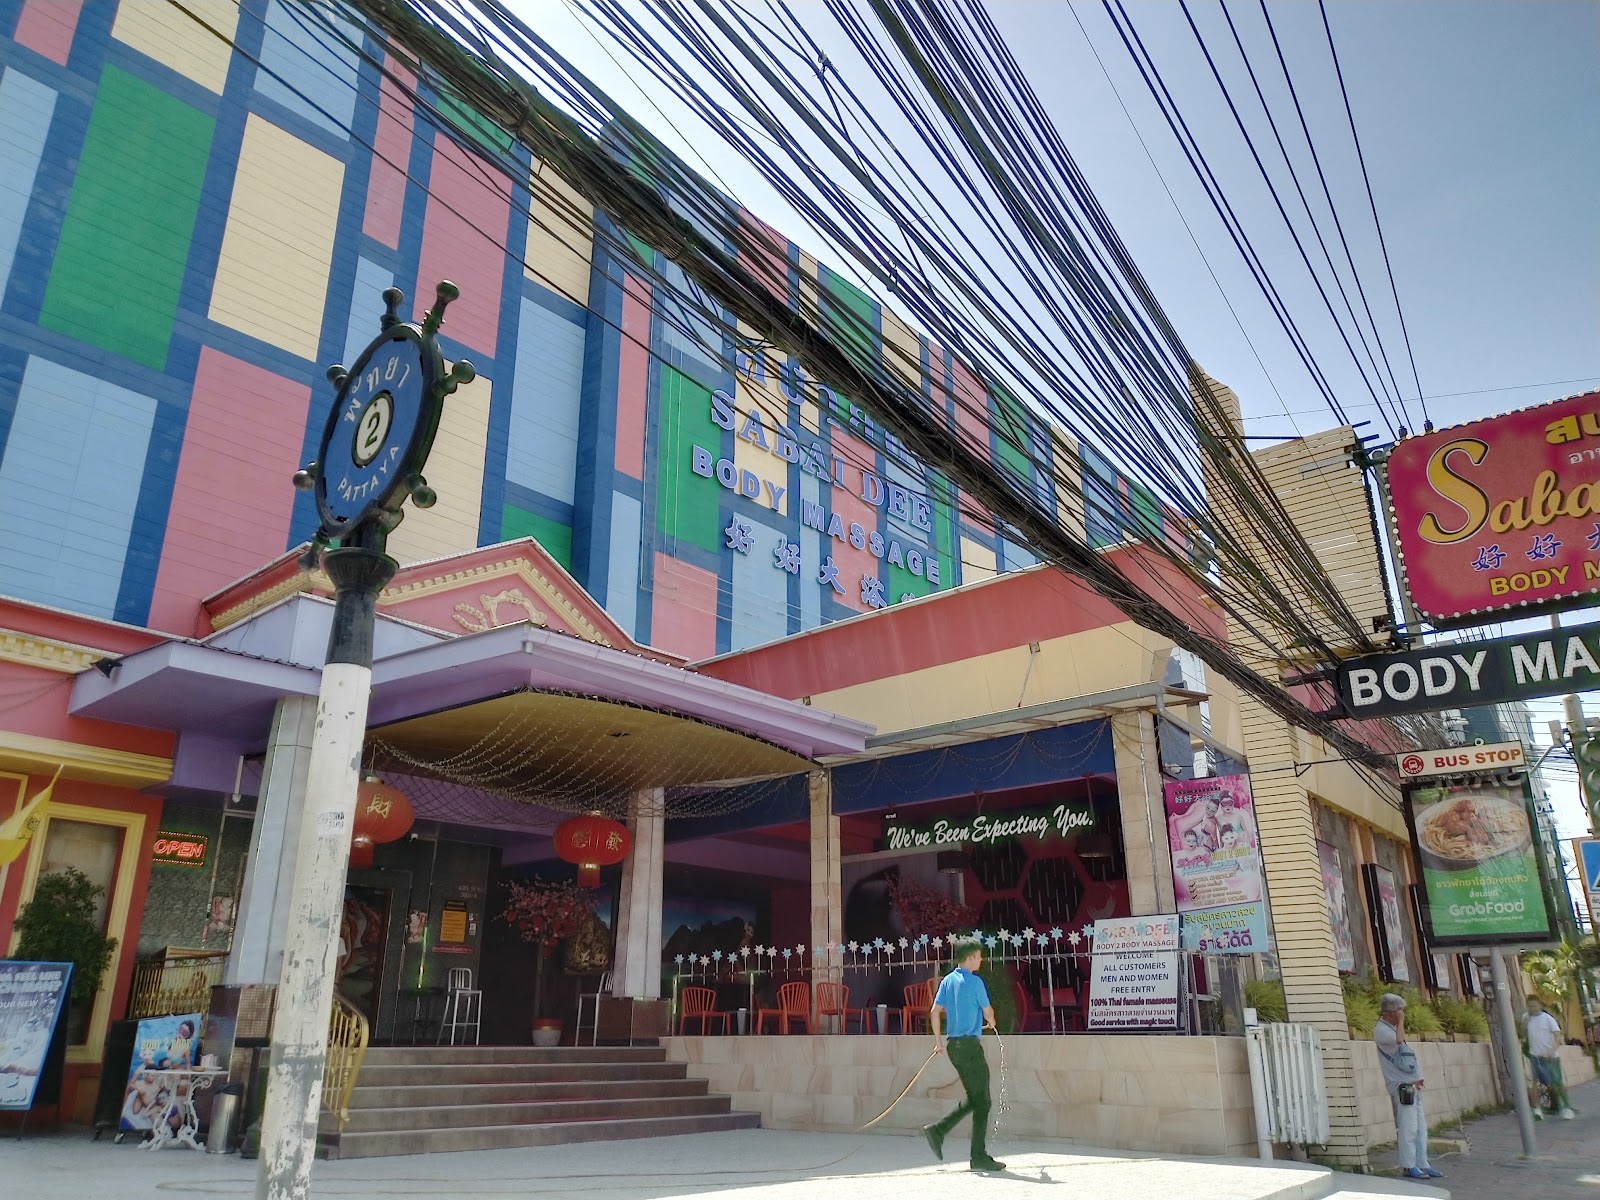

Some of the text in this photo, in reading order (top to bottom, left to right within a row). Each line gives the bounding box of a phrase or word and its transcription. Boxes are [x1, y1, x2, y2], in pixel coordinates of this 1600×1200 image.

[344, 356, 410, 423] พัทยา
[364, 411, 381, 448] 2
[710, 388, 932, 533] SABAI DEE
[337, 445, 399, 501] PATTAYA
[692, 444, 942, 585] BODY MASSAGE
[725, 515, 916, 610] 好好大浴
[1489, 565, 1570, 596] BODY
[1348, 635, 1600, 707] BODY MA
[1434, 748, 1521, 768] BUS STOP
[887, 804, 1093, 849] We've Been Expecting You.
[154, 838, 204, 858] OPEN
[1448, 899, 1525, 916] GrabFood
[1121, 941, 1141, 949] BODY
[1142, 939, 1176, 947] MASSAGE
[1103, 962, 1166, 972] ALL CUSTOMERS
[1100, 973, 1169, 983] MEN AND WOMEN
[1111, 985, 1156, 994] FREE ENTRY
[17, 999, 39, 1007] NEW
[1090, 998, 1107, 1007] 100%
[1109, 997, 1122, 1006] Thai
[1127, 1018, 1139, 1026] with
[1140, 1018, 1157, 1027] magic
[1158, 1017, 1174, 1025] touch
